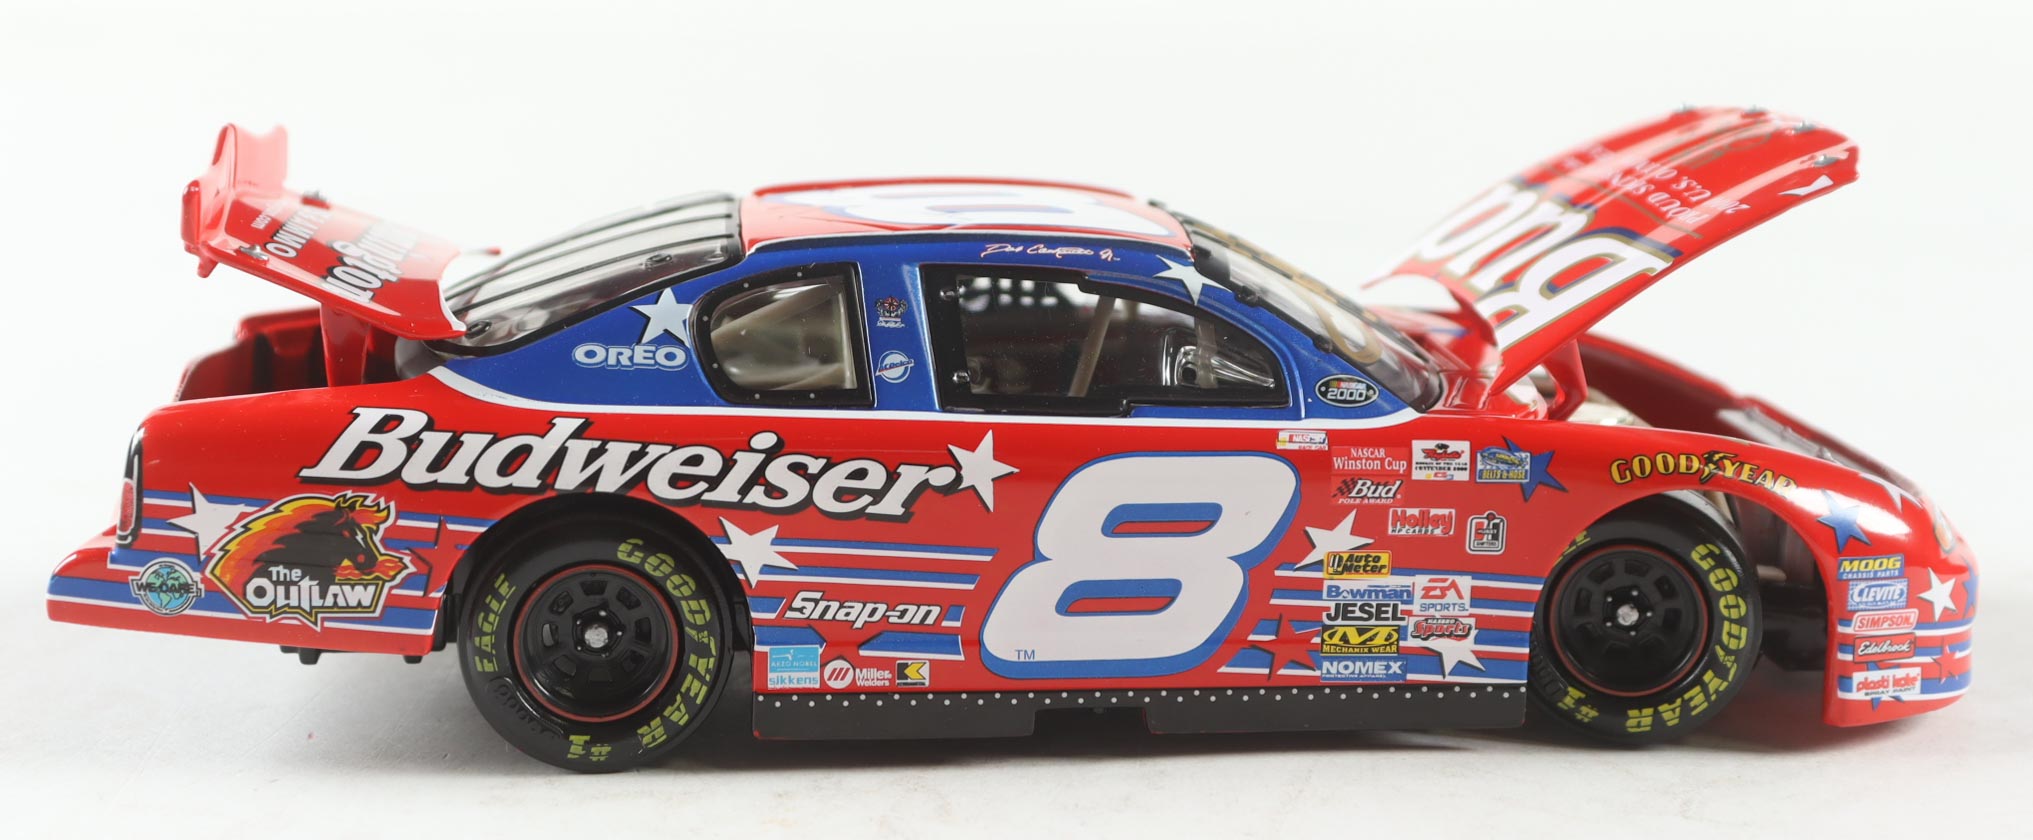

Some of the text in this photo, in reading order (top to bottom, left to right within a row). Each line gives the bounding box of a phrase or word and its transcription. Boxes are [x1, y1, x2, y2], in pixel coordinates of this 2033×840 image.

[572, 342, 689, 371] OREO
[1327, 388, 1367, 401] 2000
[1351, 448, 1386, 458] NASCAR
[299, 405, 960, 519] Budweiser
[1333, 457, 1407, 474] Winston Cup
[1348, 479, 1403, 498] Bud
[1391, 509, 1453, 535] Holley
[979, 451, 1301, 679] 8
[1345, 554, 1382, 563] Auto
[1840, 557, 1902, 572] MOOG
[268, 565, 302, 581] The
[1344, 563, 1387, 573] Meter
[1326, 585, 1412, 600] Bowman
[1420, 578, 1465, 600] EA
[784, 591, 941, 629] Snap-on
[1326, 603, 1406, 621] JESEL
[1858, 615, 1913, 629] SIMPSON
[1015, 649, 1035, 660] TM
[1322, 645, 1398, 653] MECHANIX WEAR
[1858, 640, 1911, 655] Edelbrock
[1322, 661, 1402, 674] NOMEX
[769, 675, 819, 685] sikkens
[857, 678, 890, 687] Welders
[566, 734, 612, 761] #1
